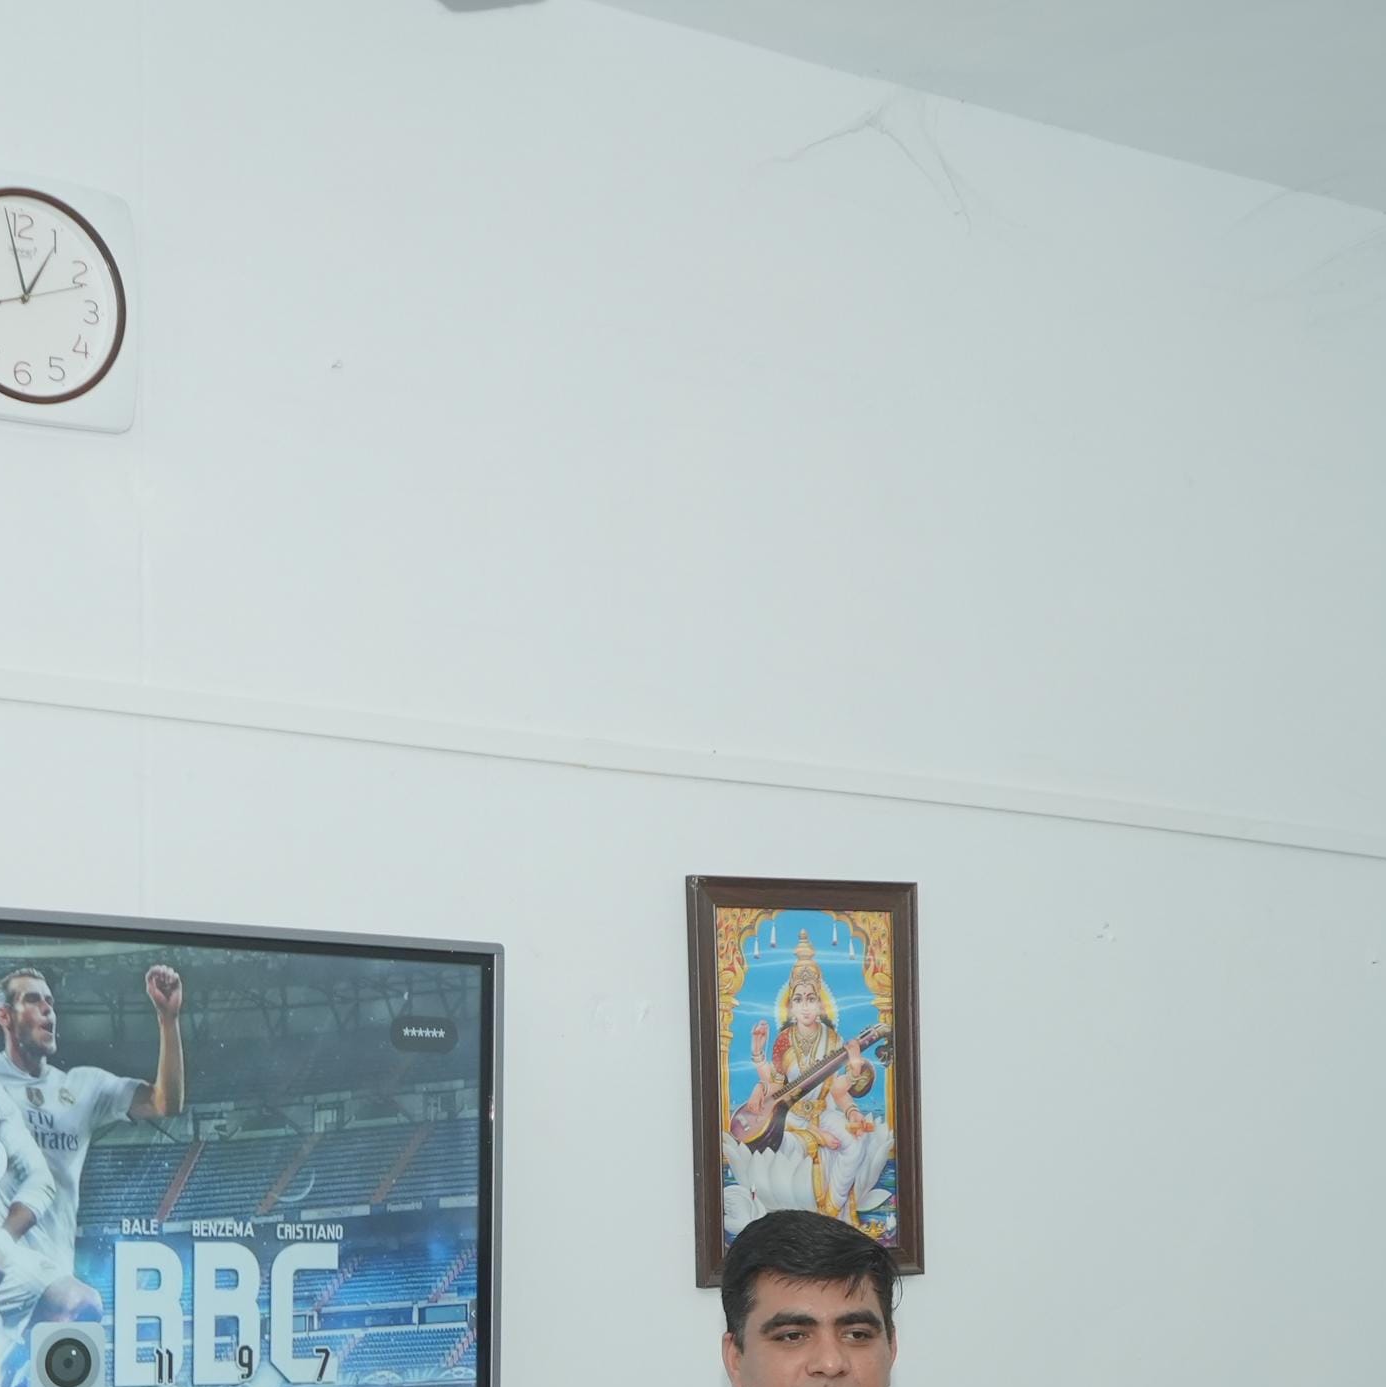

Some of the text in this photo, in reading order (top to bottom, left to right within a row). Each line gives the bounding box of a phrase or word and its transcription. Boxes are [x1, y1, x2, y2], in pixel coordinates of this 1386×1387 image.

[12, 212, 33, 240] 12
[51, 229, 57, 254] 1
[72, 260, 88, 287] 2
[84, 300, 99, 325] 3
[72, 334, 89, 359] 4
[14, 361, 32, 386] 6
[48, 356, 66, 382] 5
[121, 1219, 159, 1236] BALE
[192, 1221, 255, 1237] BENZEMA
[276, 1224, 344, 1240] CRISTIANO
[156, 1348, 173, 1385] 11
[238, 1345, 254, 1380] 9
[315, 1348, 331, 1382] 7
